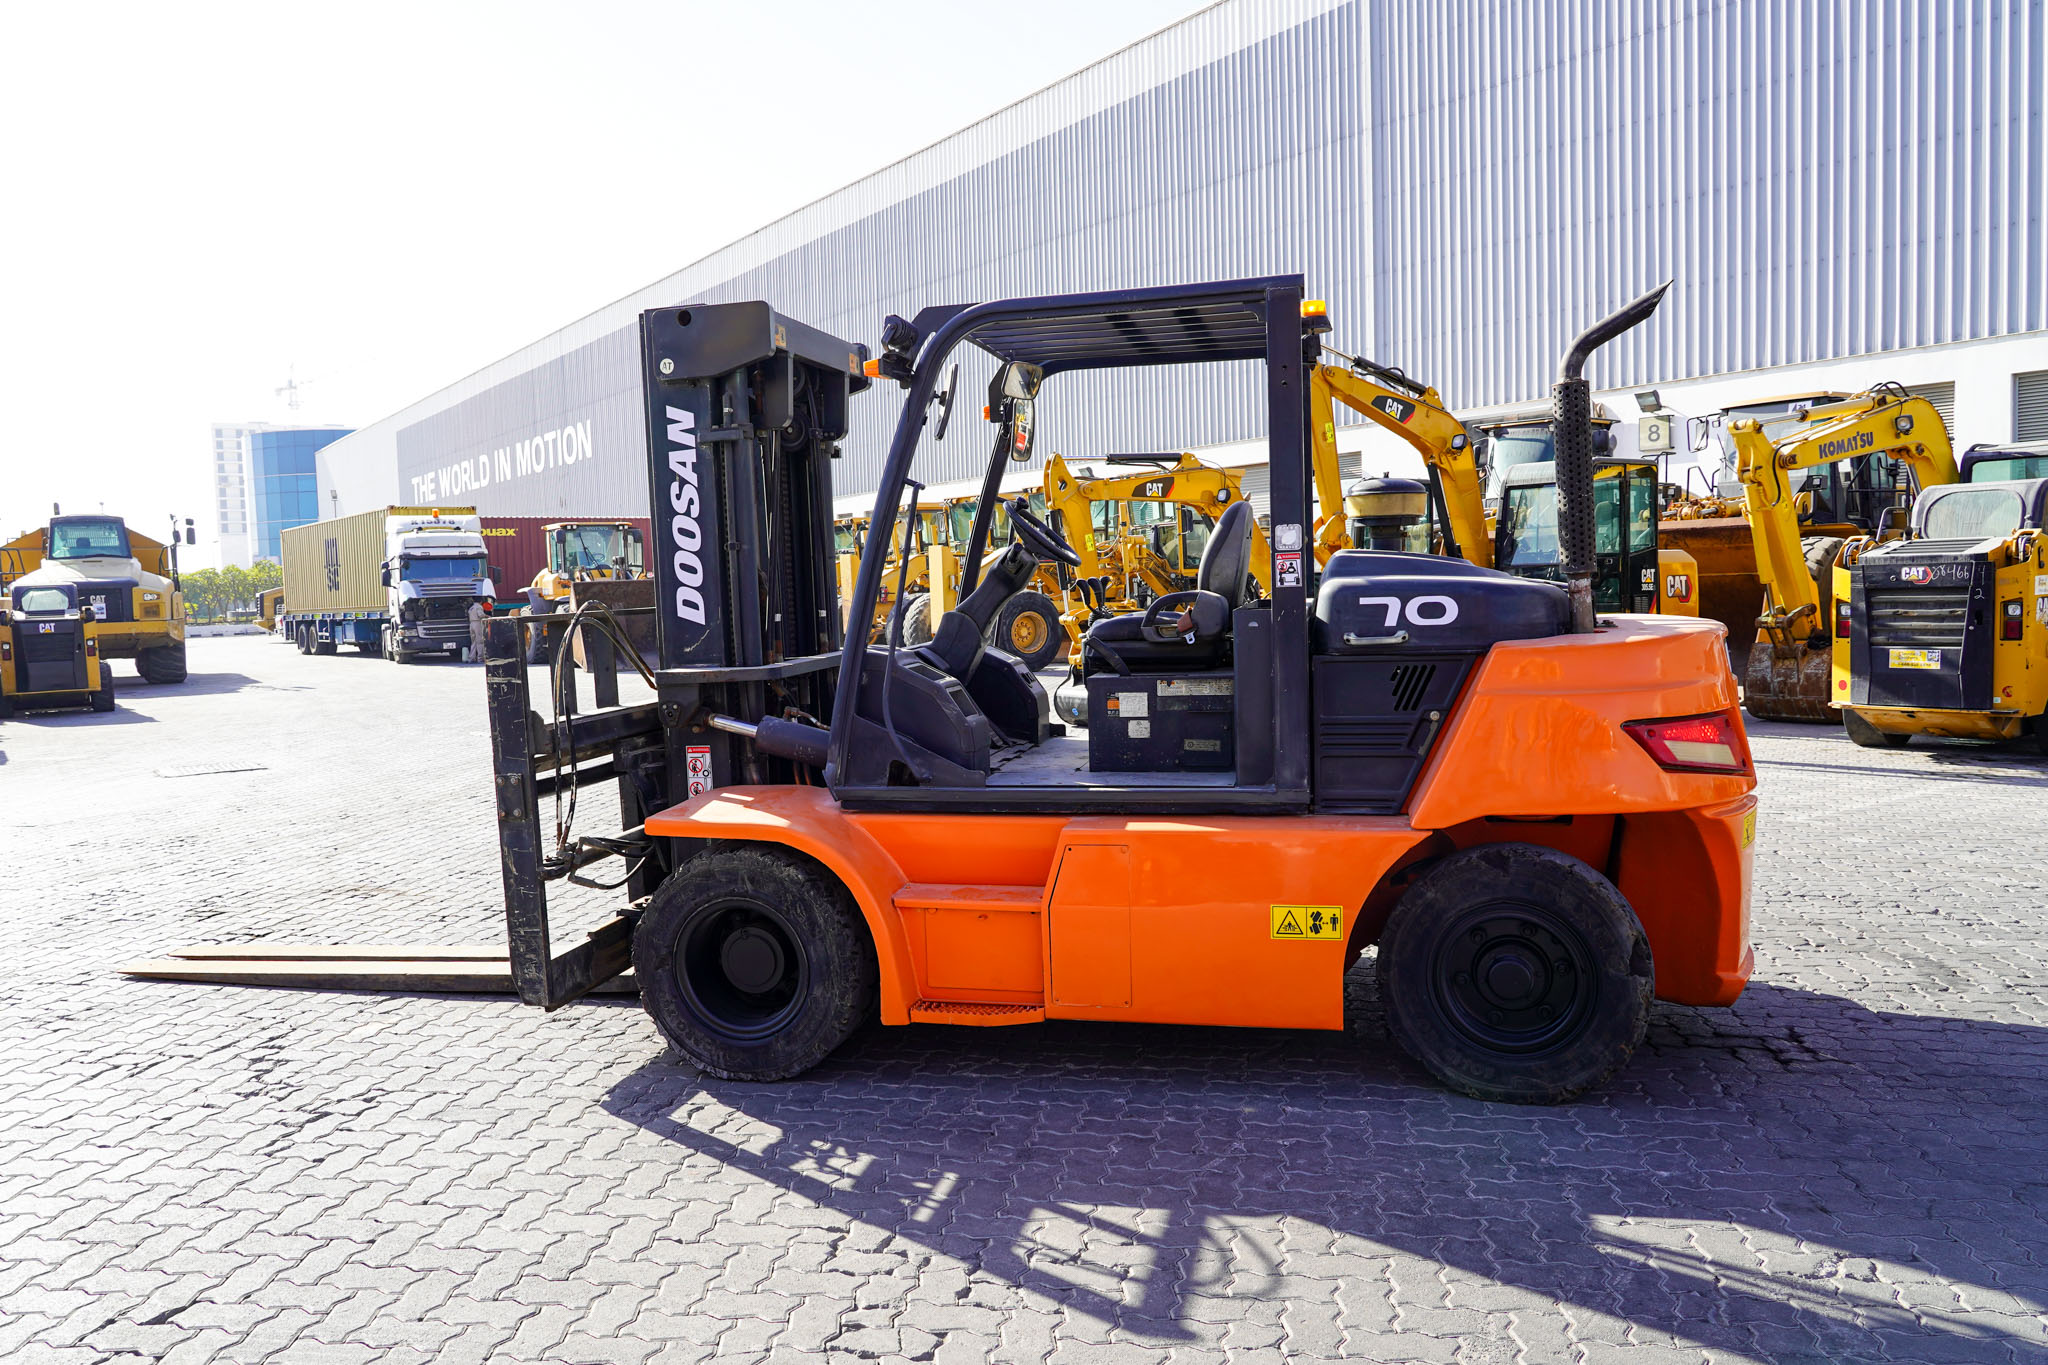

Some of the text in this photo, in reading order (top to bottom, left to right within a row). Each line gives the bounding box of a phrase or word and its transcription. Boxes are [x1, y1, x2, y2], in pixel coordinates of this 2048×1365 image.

[662, 361, 673, 371] AT
[1385, 398, 1403, 420] CAT
[1648, 424, 1660, 442] 8
[1819, 431, 1874, 459] KOMATSU
[411, 419, 593, 505] THE WORLD IN MOTION
[1146, 483, 1163, 497] CAT
[665, 405, 706, 625] DOOSAN
[1641, 568, 1656, 583] CAT
[1901, 566, 1925, 581] CAT
[1667, 575, 1687, 597] CAT
[90, 595, 106, 605] CAT
[1359, 595, 1459, 627] 70
[39, 623, 56, 633] CAT
